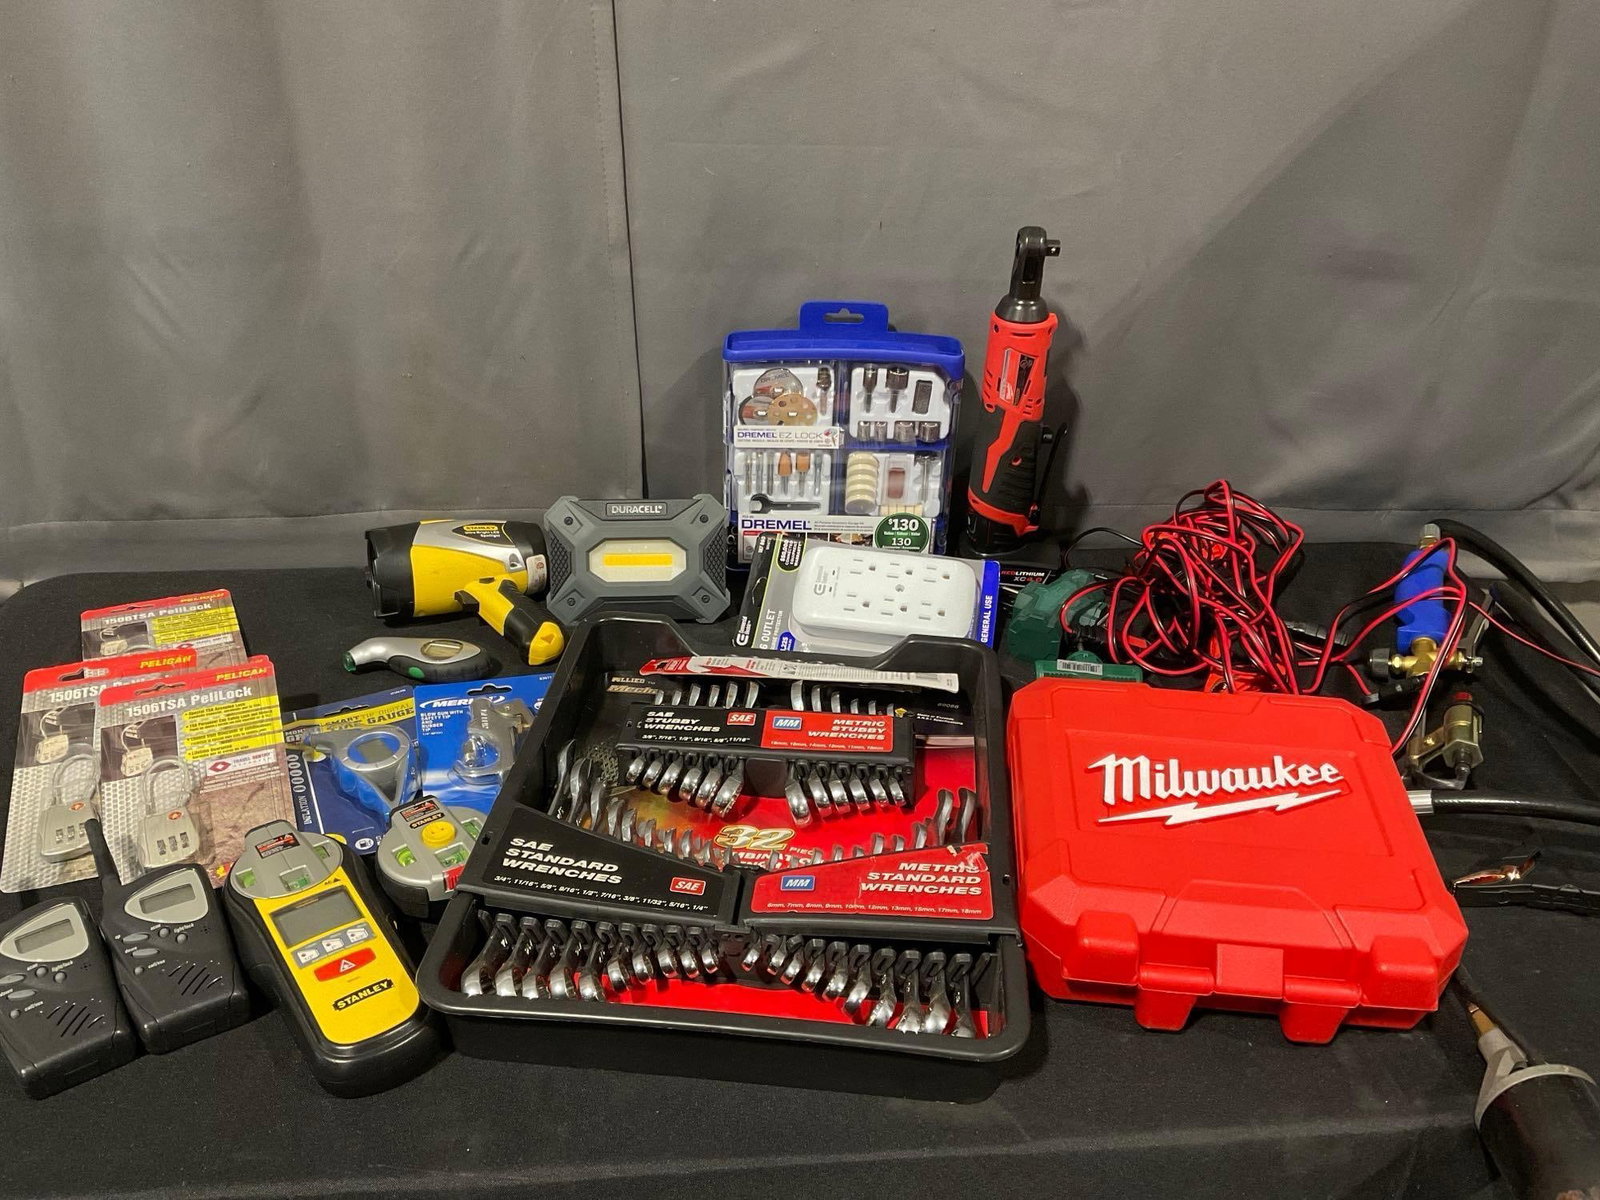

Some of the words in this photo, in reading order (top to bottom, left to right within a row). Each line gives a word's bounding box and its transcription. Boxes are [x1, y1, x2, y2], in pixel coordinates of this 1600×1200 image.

[612, 505, 660, 514] DURACELL
[741, 520, 812, 530] DREMEL
[888, 518, 919, 532] $130
[891, 538, 912, 546] 130
[984, 595, 993, 609] USE
[159, 602, 212, 616] PeliLock
[761, 609, 776, 640] OUTLET
[980, 610, 992, 644] GENERAL
[139, 655, 192, 668] PELICAN
[216, 668, 267, 681] PELICAN
[611, 676, 645, 684] ALLIED
[126, 697, 186, 718] 1506TSA
[190, 686, 252, 706] PeliLock
[367, 707, 414, 724] GAUGE
[729, 714, 754, 723] SAE
[644, 724, 720, 732] WRENCHES
[775, 719, 800, 727] MM
[833, 719, 885, 727] METRIC
[808, 731, 885, 741] WRENCHES
[1088, 753, 1344, 805] Milwaukee
[298, 796, 312, 825] INFLATION
[411, 813, 442, 828] STANLEY
[714, 824, 795, 850] 32
[510, 838, 553, 851] SAE
[506, 848, 619, 872] STANDARD
[502, 858, 623, 884] WRENCHES
[898, 862, 980, 873] METRIC
[784, 878, 811, 888] MM
[867, 872, 981, 884] STANDARD
[674, 880, 700, 892] SAE
[860, 883, 982, 896] WRENCHES
[337, 981, 389, 1008] STANLEY
